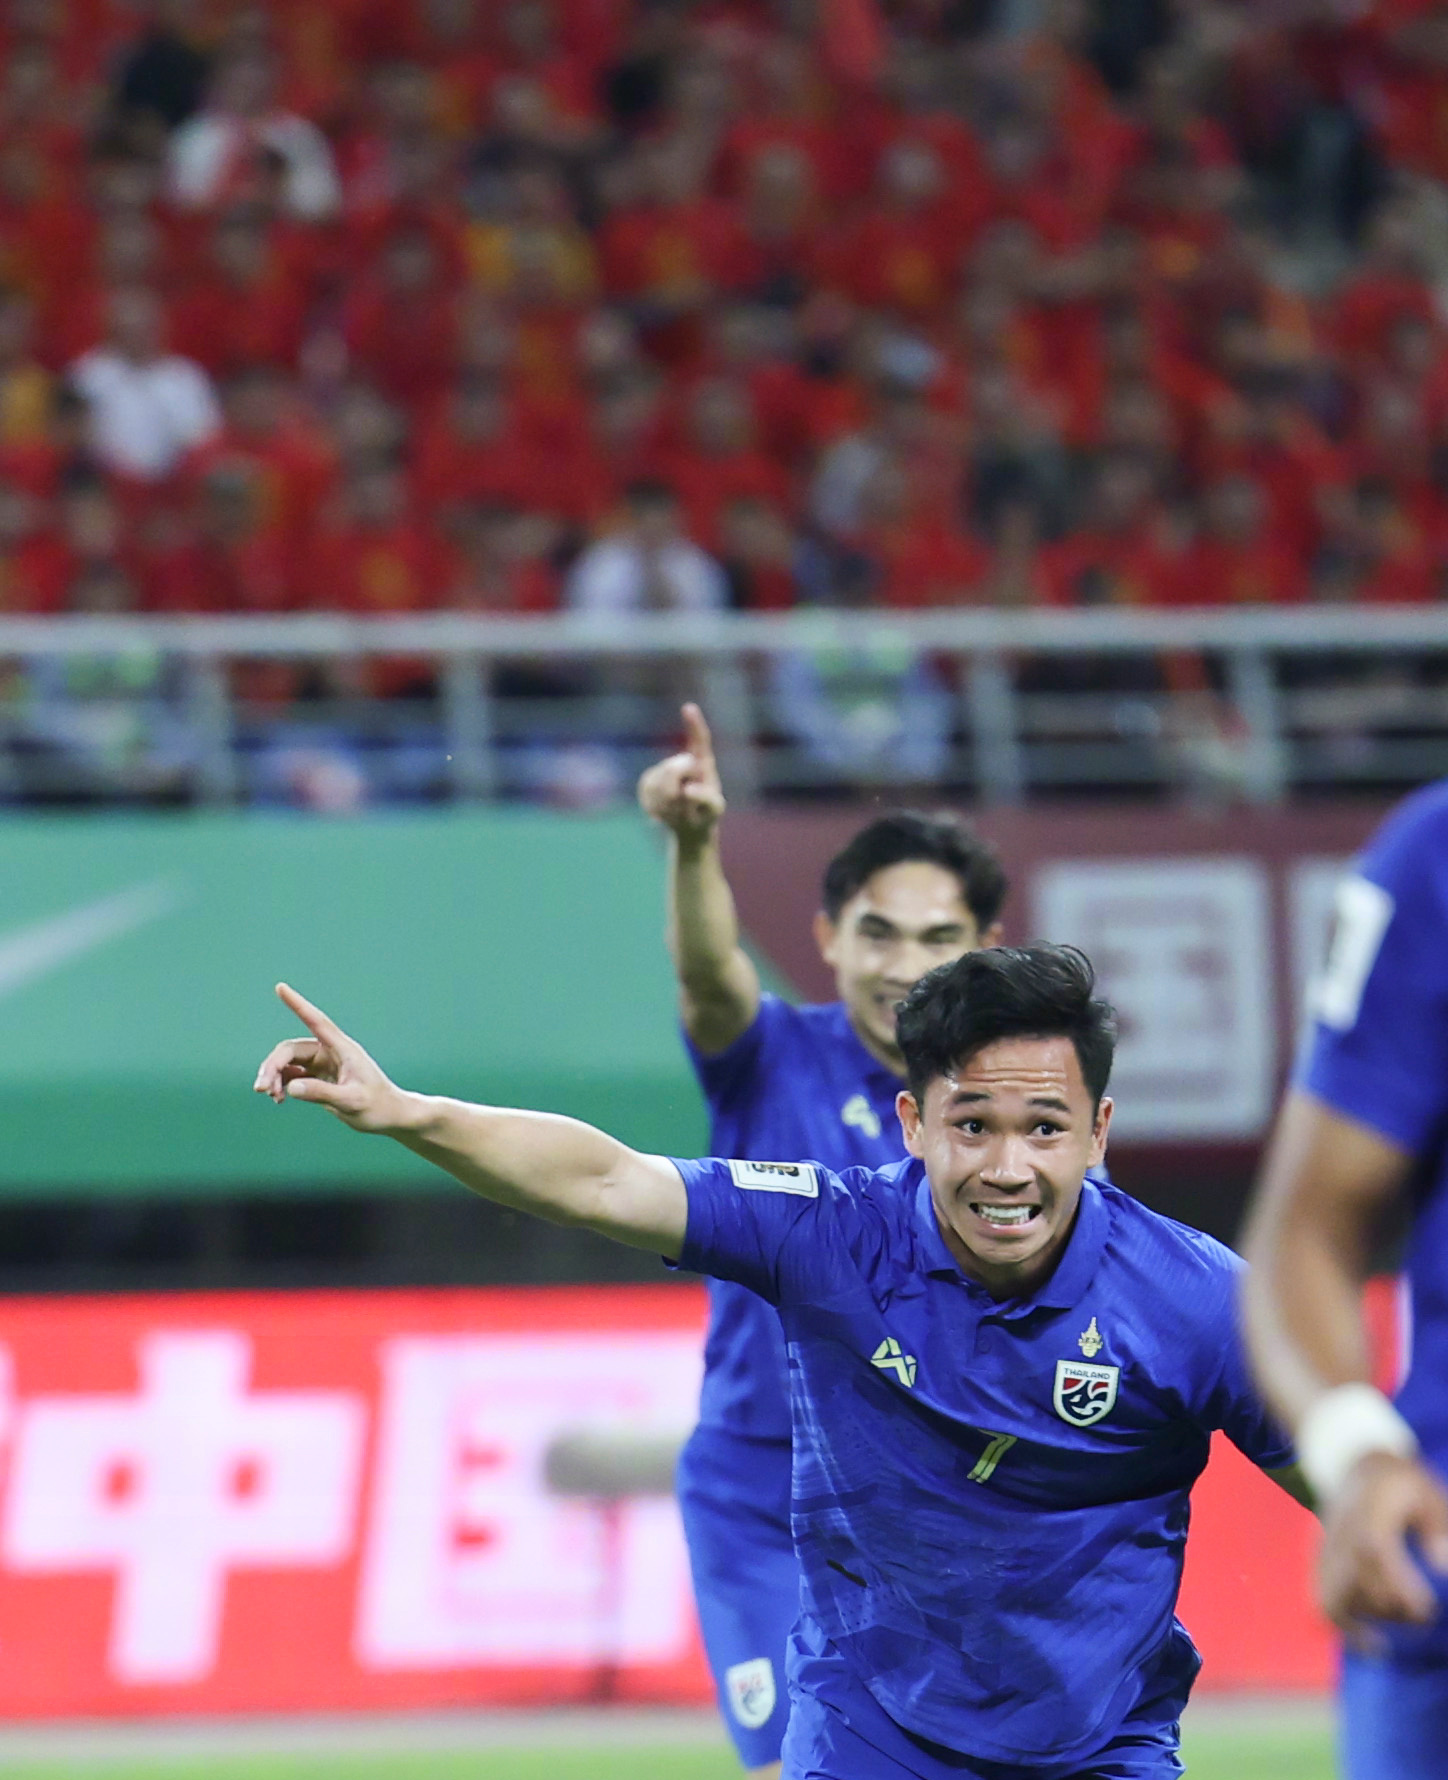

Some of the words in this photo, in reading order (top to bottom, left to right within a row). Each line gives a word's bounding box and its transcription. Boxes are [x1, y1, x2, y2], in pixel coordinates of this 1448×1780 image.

[1033, 857, 1345, 1140] 国
[967, 1428, 1018, 1483] 7
[1064, 1367, 1111, 1380] THAILAND
[0, 1328, 706, 1684] 中国
